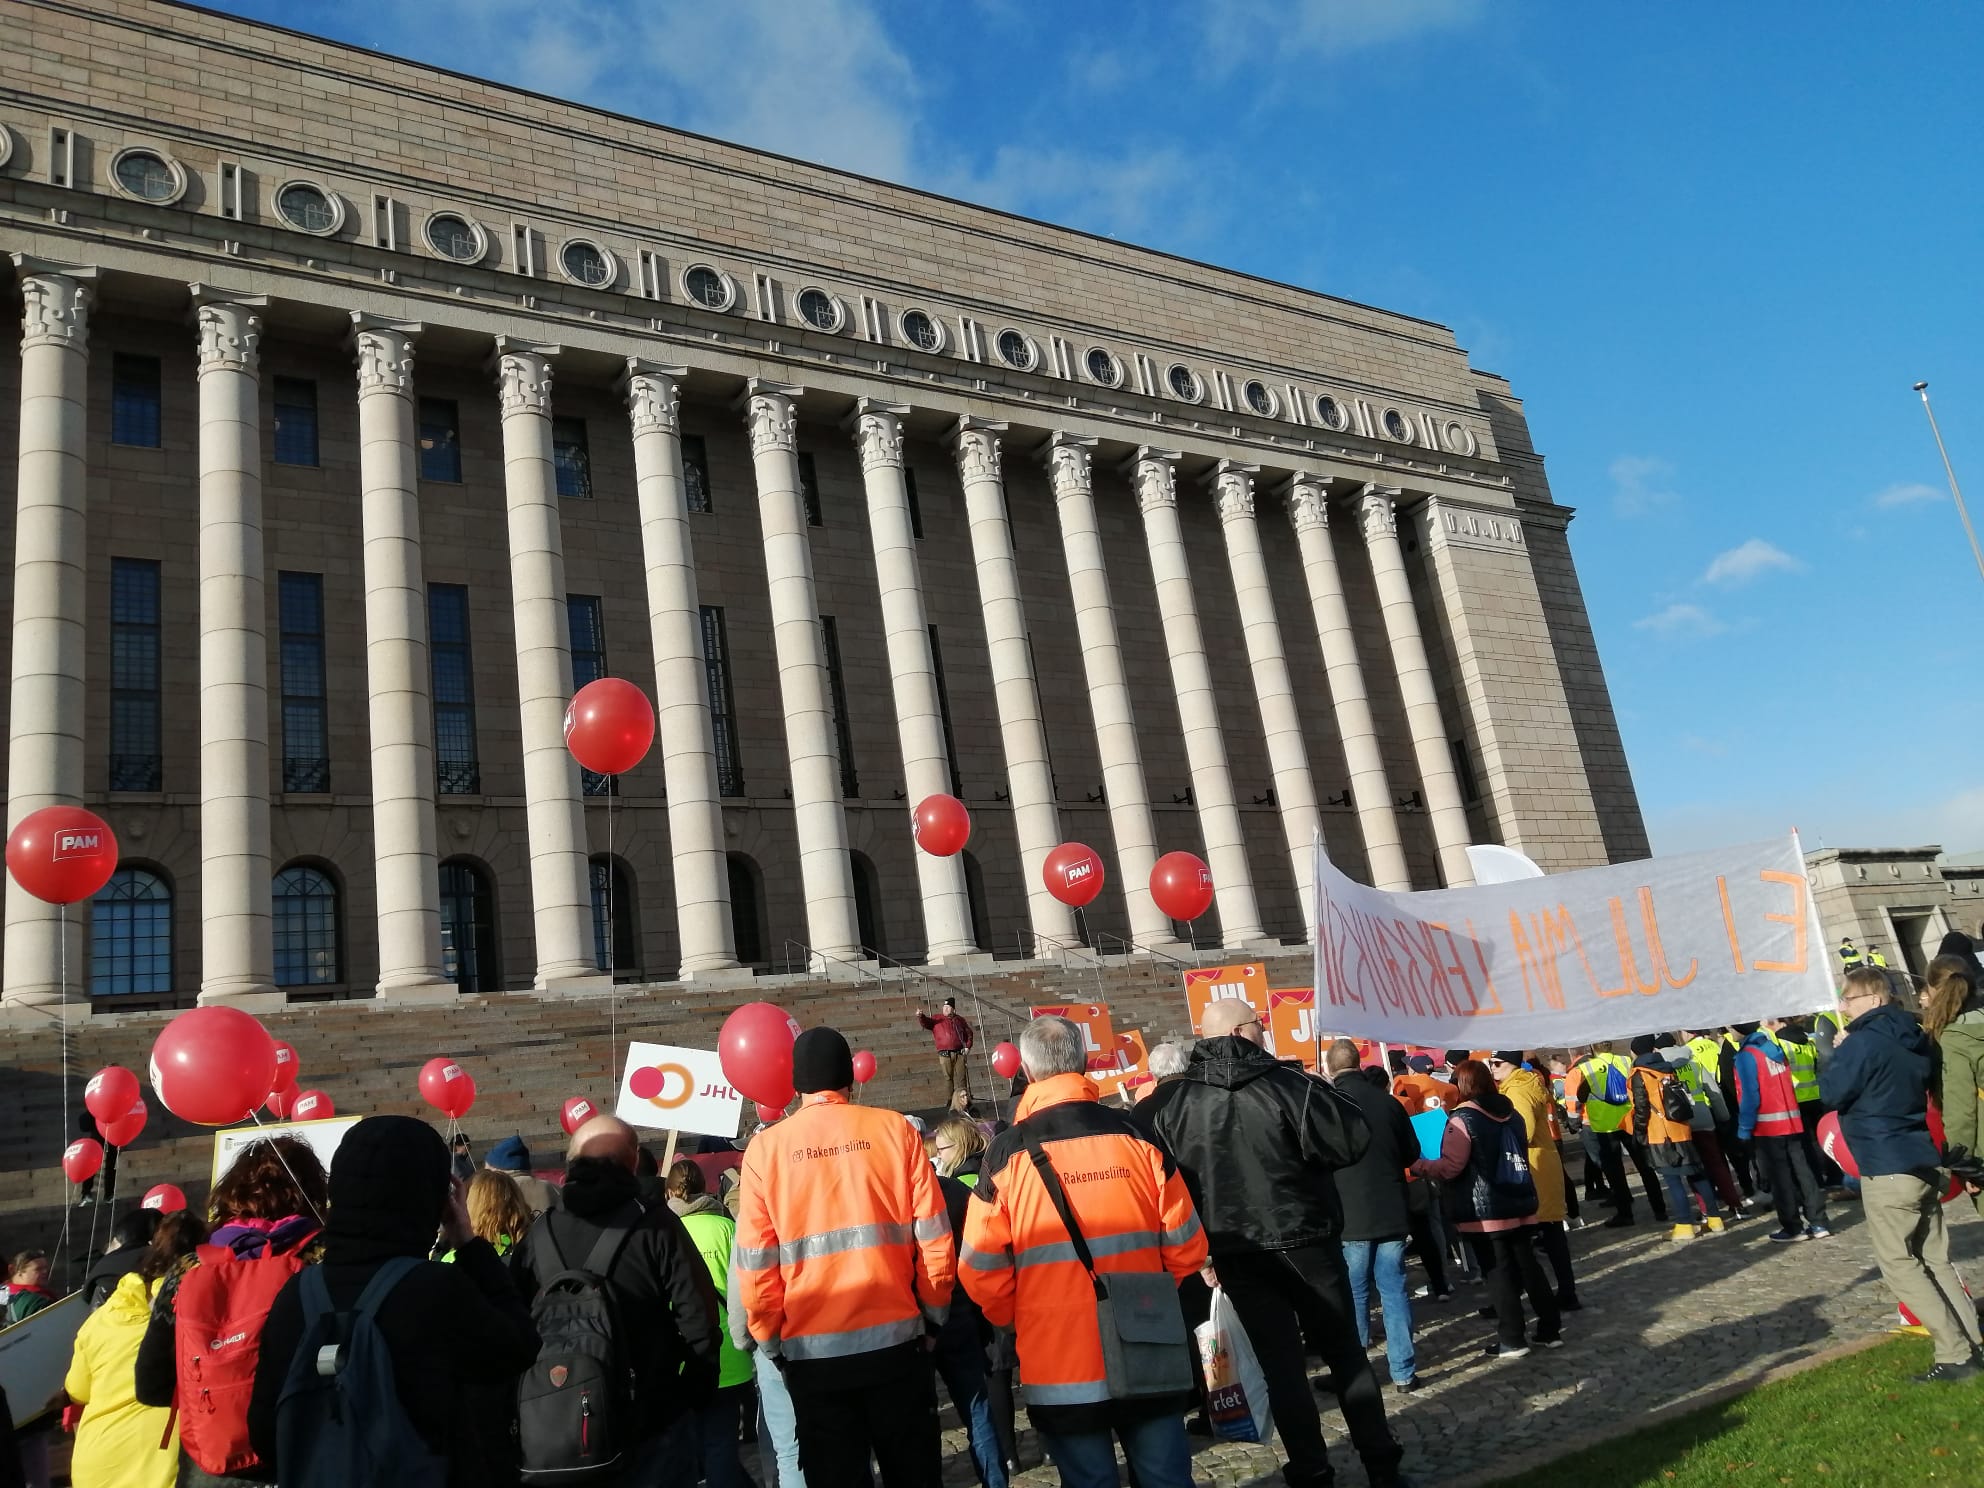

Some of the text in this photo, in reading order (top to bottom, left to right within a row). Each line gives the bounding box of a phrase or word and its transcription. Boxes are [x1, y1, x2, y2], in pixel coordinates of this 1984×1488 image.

[62, 835, 98, 850] PAM
[1069, 864, 1090, 880] PAM
[700, 1084, 738, 1101] JHL
[806, 1139, 871, 1160] Rakennusliitto
[1063, 1166, 1131, 1185] Rakennusliitto
[1213, 1391, 1242, 1412] rket
